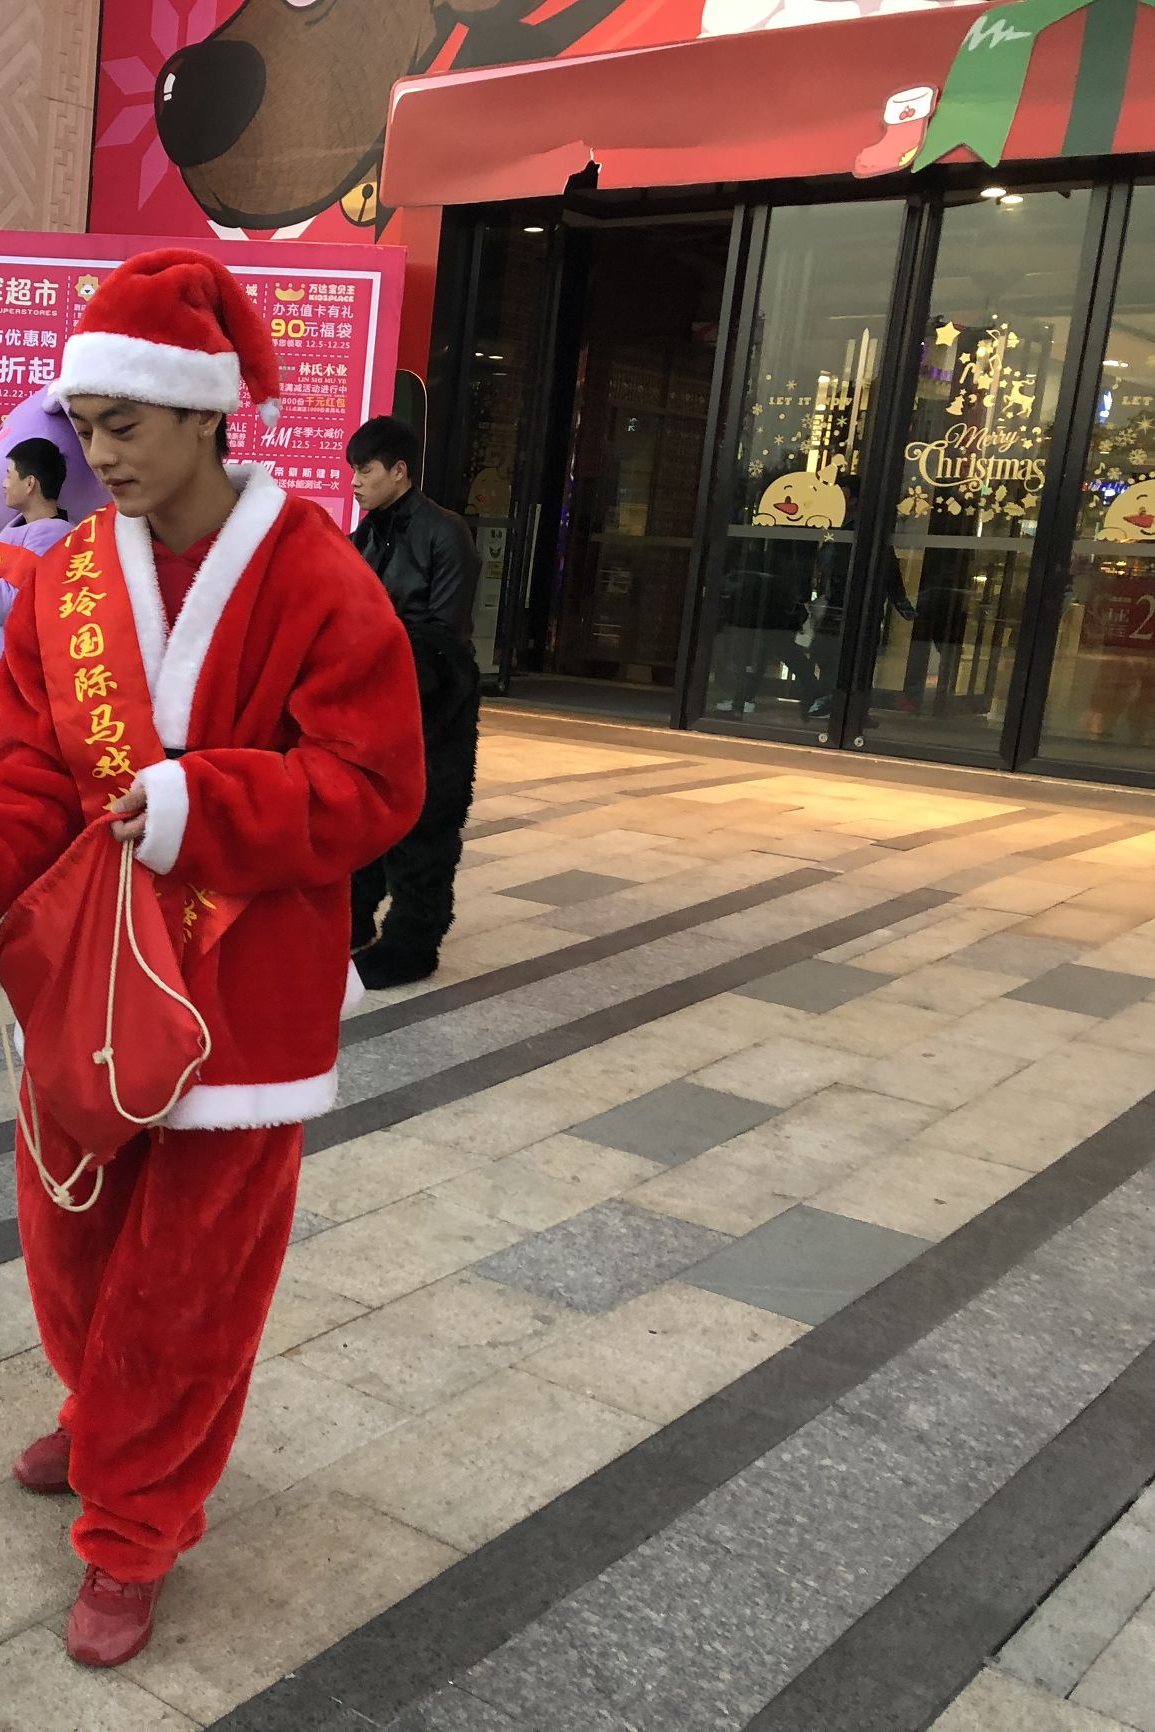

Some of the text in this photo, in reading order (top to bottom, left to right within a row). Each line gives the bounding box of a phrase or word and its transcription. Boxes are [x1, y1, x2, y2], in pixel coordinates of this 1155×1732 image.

[272, 302, 354, 319] 办充值卡有礼
[270, 318, 353, 339] 90元福袋
[306, 340, 351, 349] 12.5-12.25
[299, 362, 347, 376] 林氏木业
[768, 396, 793, 406] LET
[798, 396, 812, 406] IT
[1122, 395, 1153, 406] LET
[260, 426, 292, 448] H&M
[293, 426, 344, 440] 冬季大减价
[946, 422, 1019, 453] Merry
[291, 440, 310, 449] 12.5
[319, 441, 343, 450] 12.25
[905, 439, 1047, 492] Christmas
[274, 466, 340, 480] 帝豪斯健身
[59, 512, 138, 812] 门灵玲国际马戏
